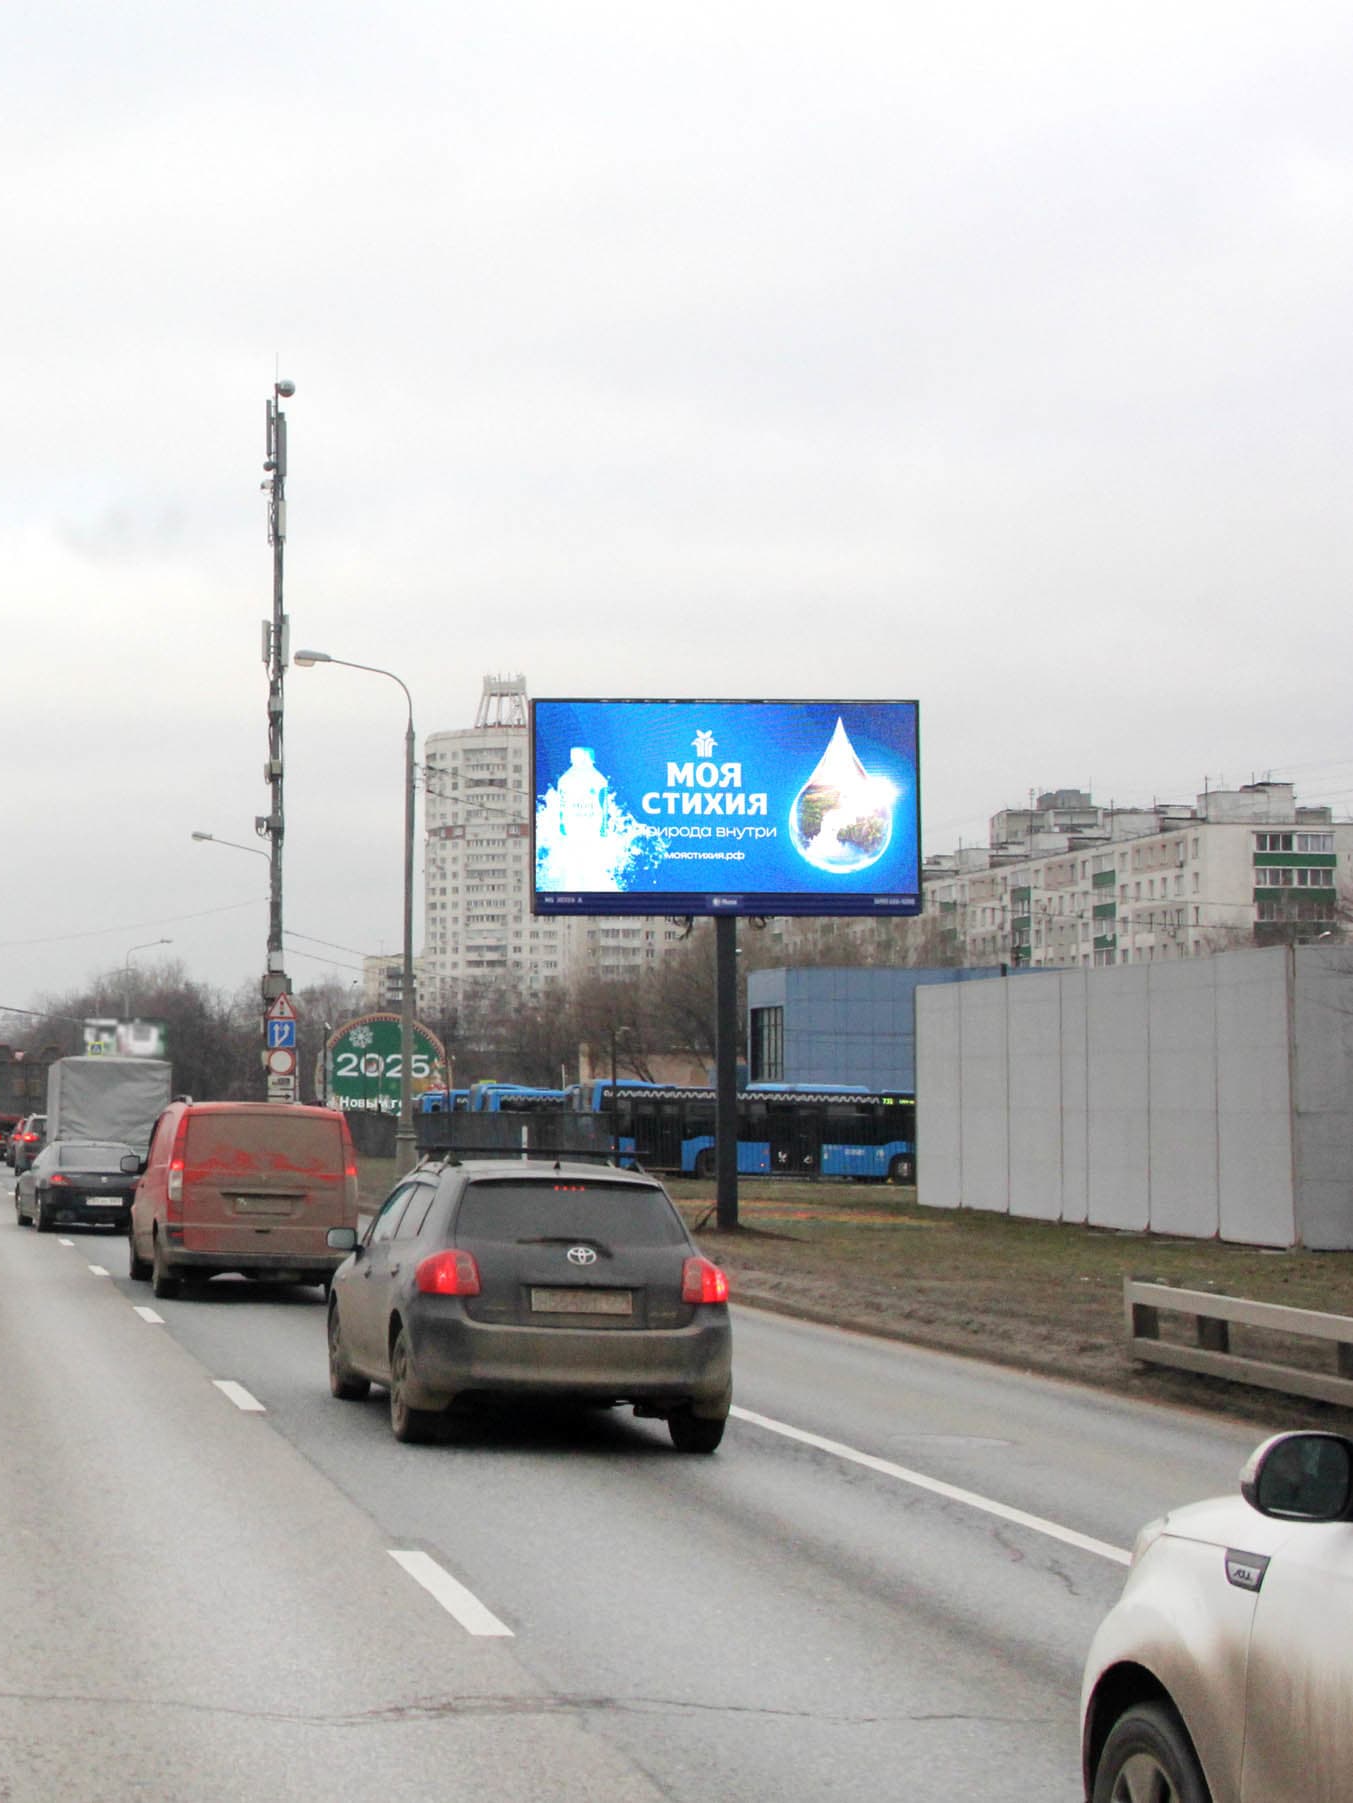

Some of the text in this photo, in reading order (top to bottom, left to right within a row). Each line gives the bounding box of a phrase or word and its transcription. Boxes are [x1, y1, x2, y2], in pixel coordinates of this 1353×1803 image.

[666, 762, 742, 788] МОЯ
[641, 792, 768, 816] СТИХИЯ
[715, 826, 777, 840] внутри
[336, 1053, 431, 1078] 2025
